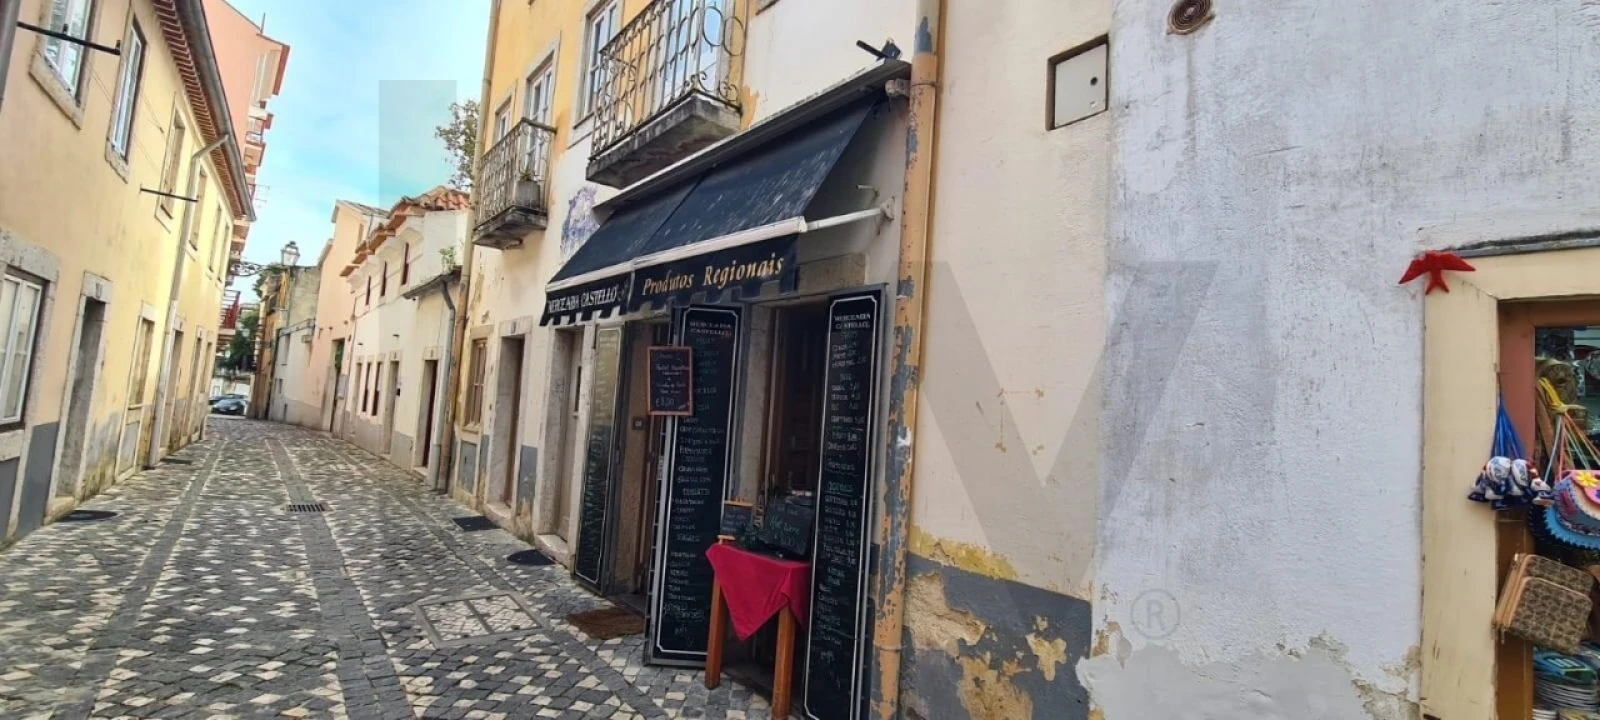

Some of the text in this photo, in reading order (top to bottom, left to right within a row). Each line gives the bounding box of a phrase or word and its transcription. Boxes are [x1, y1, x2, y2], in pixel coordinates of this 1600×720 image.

[642, 253, 785, 296] Produtos Regionais
[581, 284, 617, 307] CASTELLO
